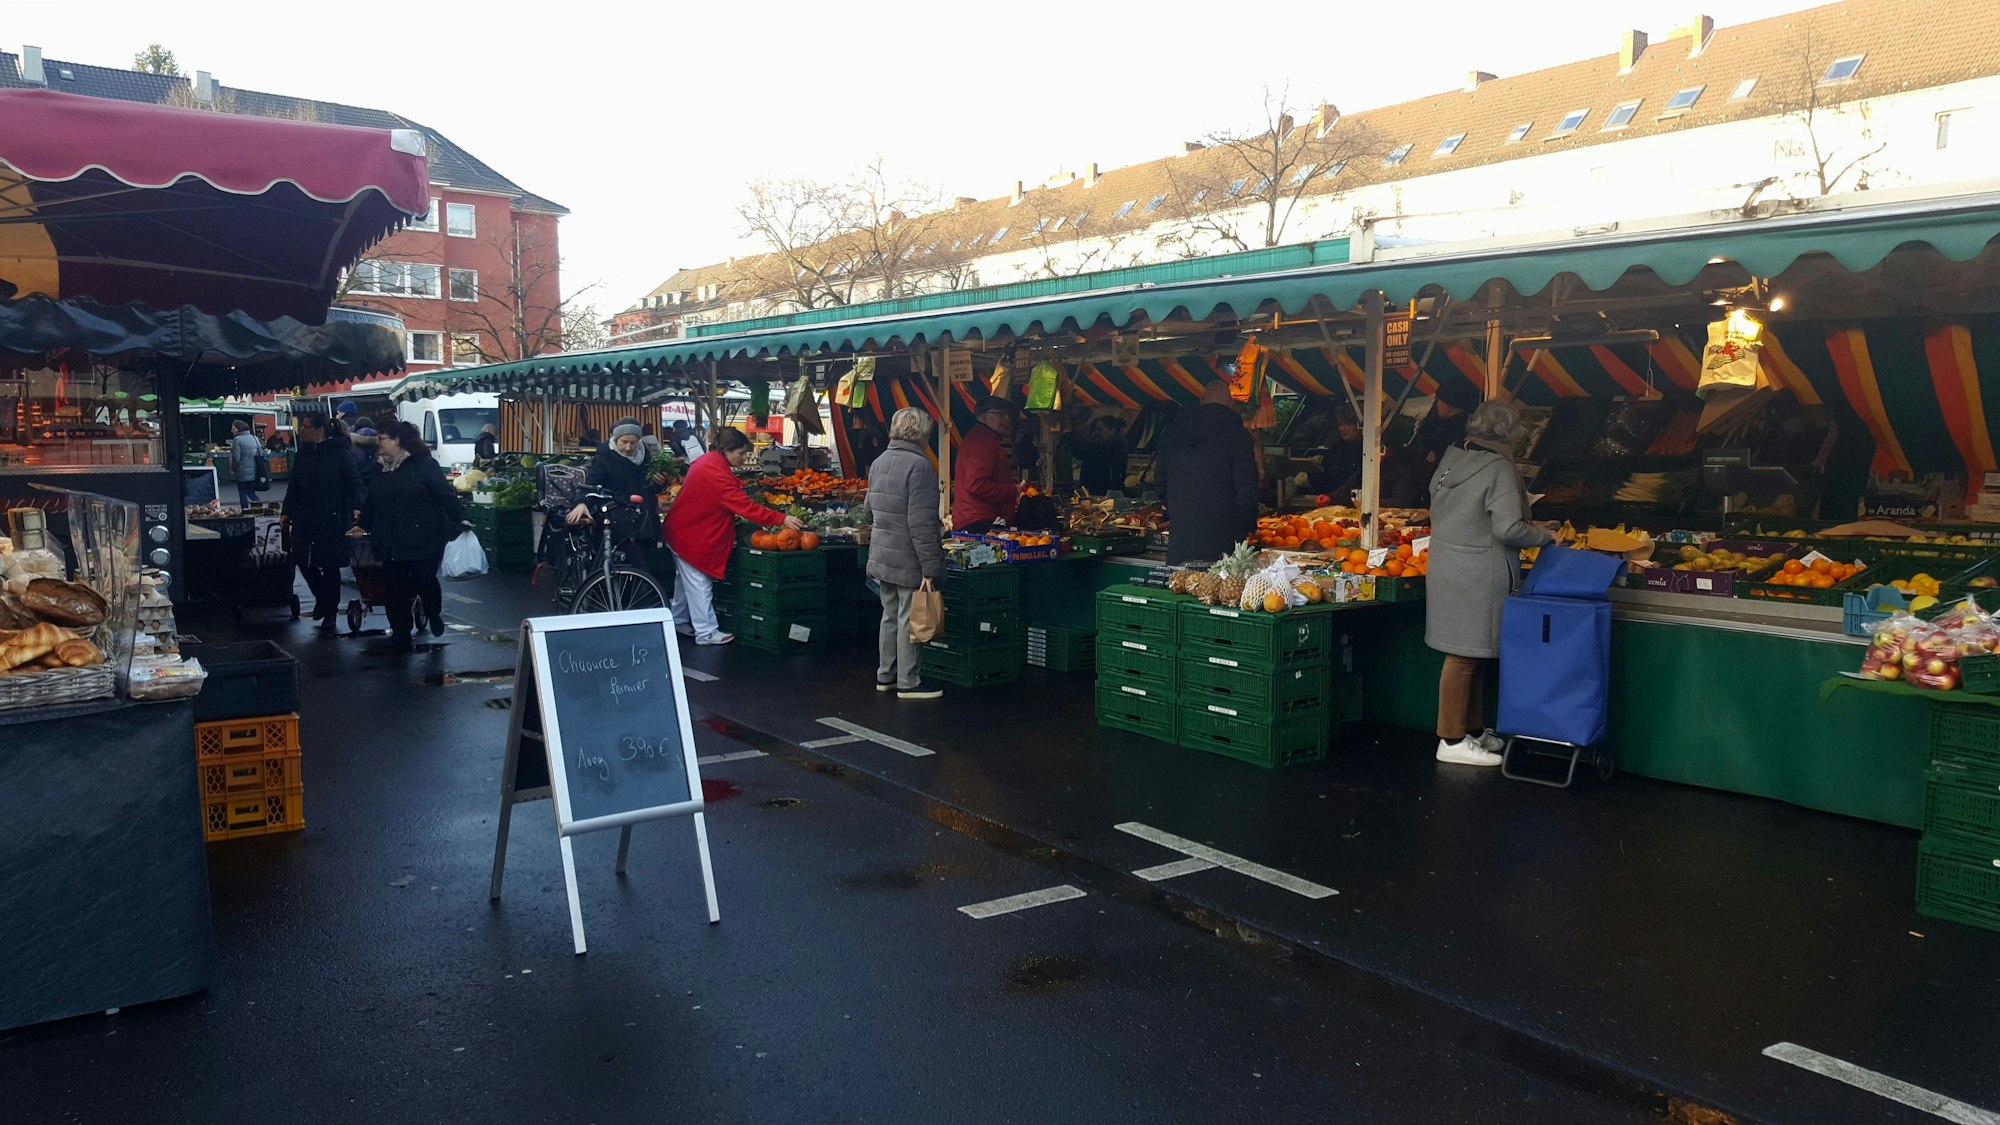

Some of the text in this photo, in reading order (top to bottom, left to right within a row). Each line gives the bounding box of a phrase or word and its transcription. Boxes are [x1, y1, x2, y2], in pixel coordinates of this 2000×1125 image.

[1386, 320, 1409, 334] CASH
[1386, 333, 1409, 347] ONLY
[1876, 504, 1916, 516] Aranda
[1746, 544, 1764, 552] xenia
[1647, 576, 1667, 587] xenia
[559, 650, 620, 674] Chaource
